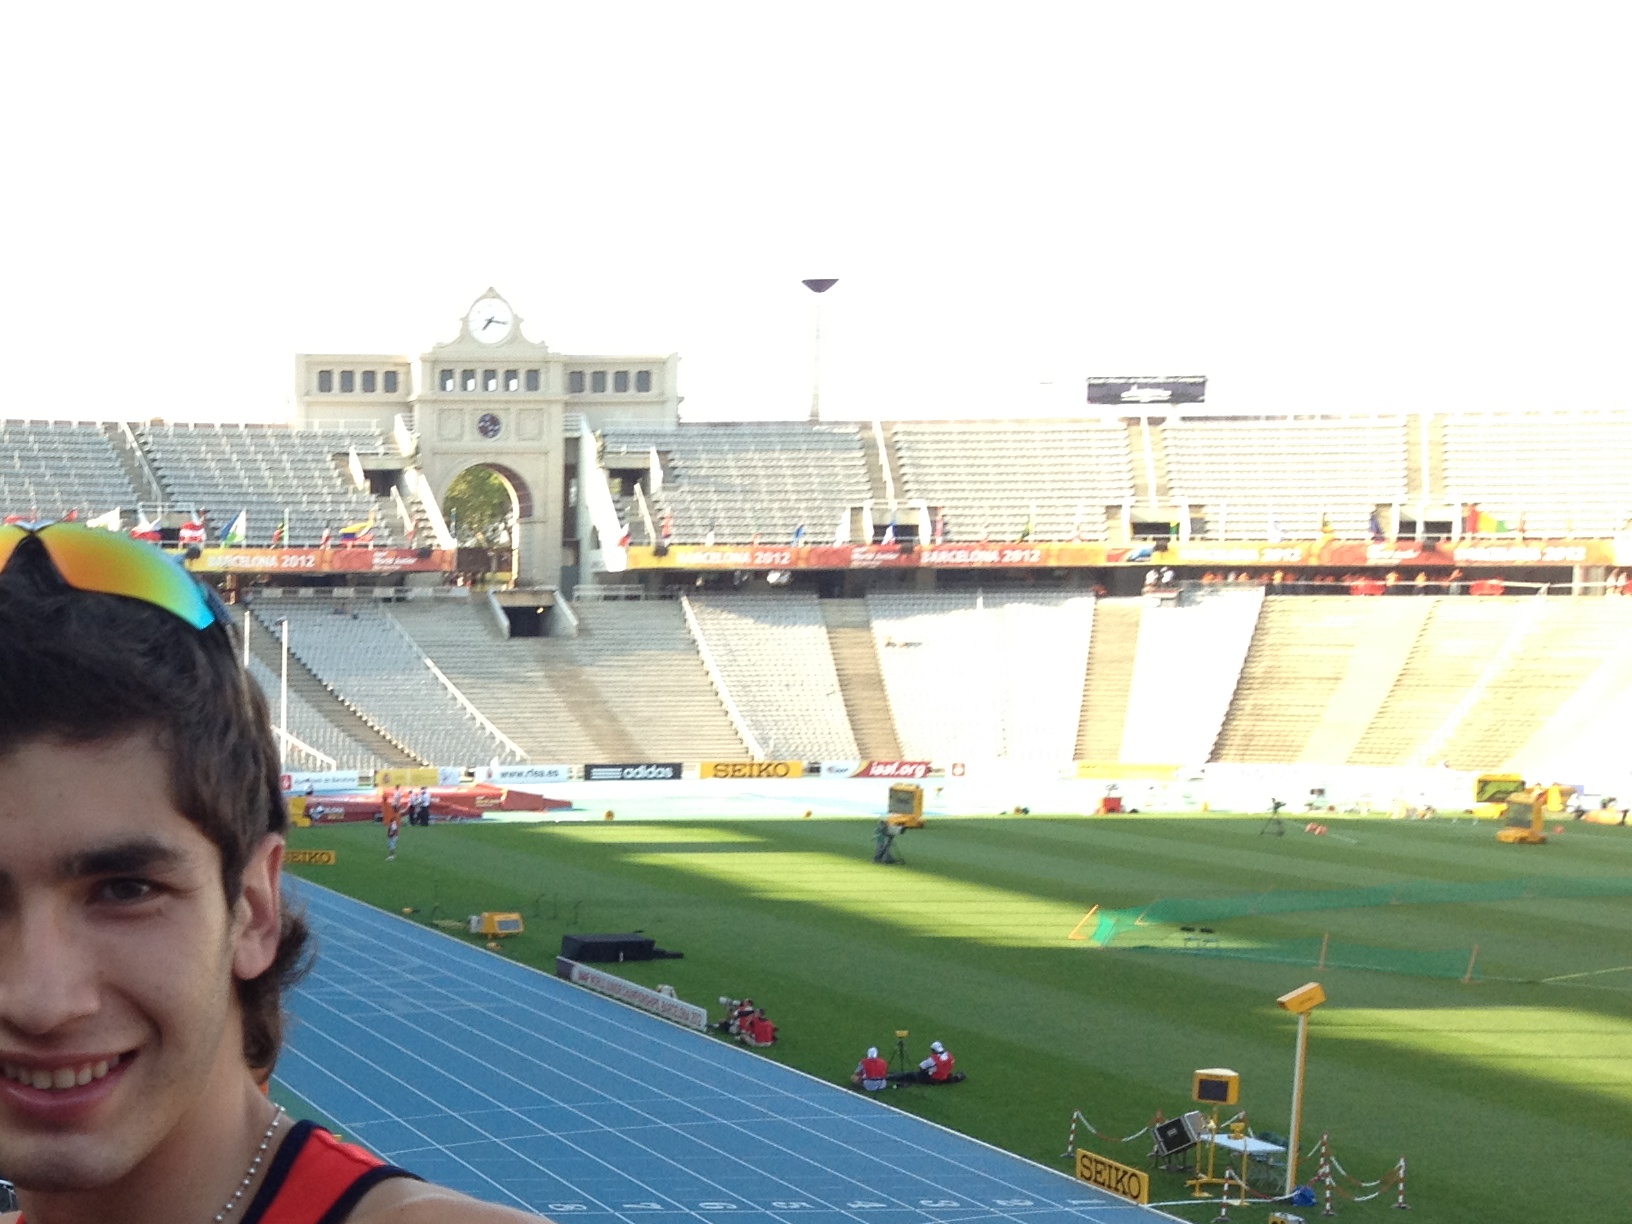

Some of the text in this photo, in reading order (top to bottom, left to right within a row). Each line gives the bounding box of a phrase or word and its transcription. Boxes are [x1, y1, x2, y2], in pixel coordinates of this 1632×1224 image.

[207, 555, 315, 568] BARCELONA 2012
[754, 551, 791, 564] 2012
[1002, 549, 1041, 562] 2012
[622, 765, 673, 779] adidas
[712, 762, 790, 778] SEIKO
[868, 761, 927, 778] iaaf.org
[1079, 1153, 1142, 1200] SEIKO
